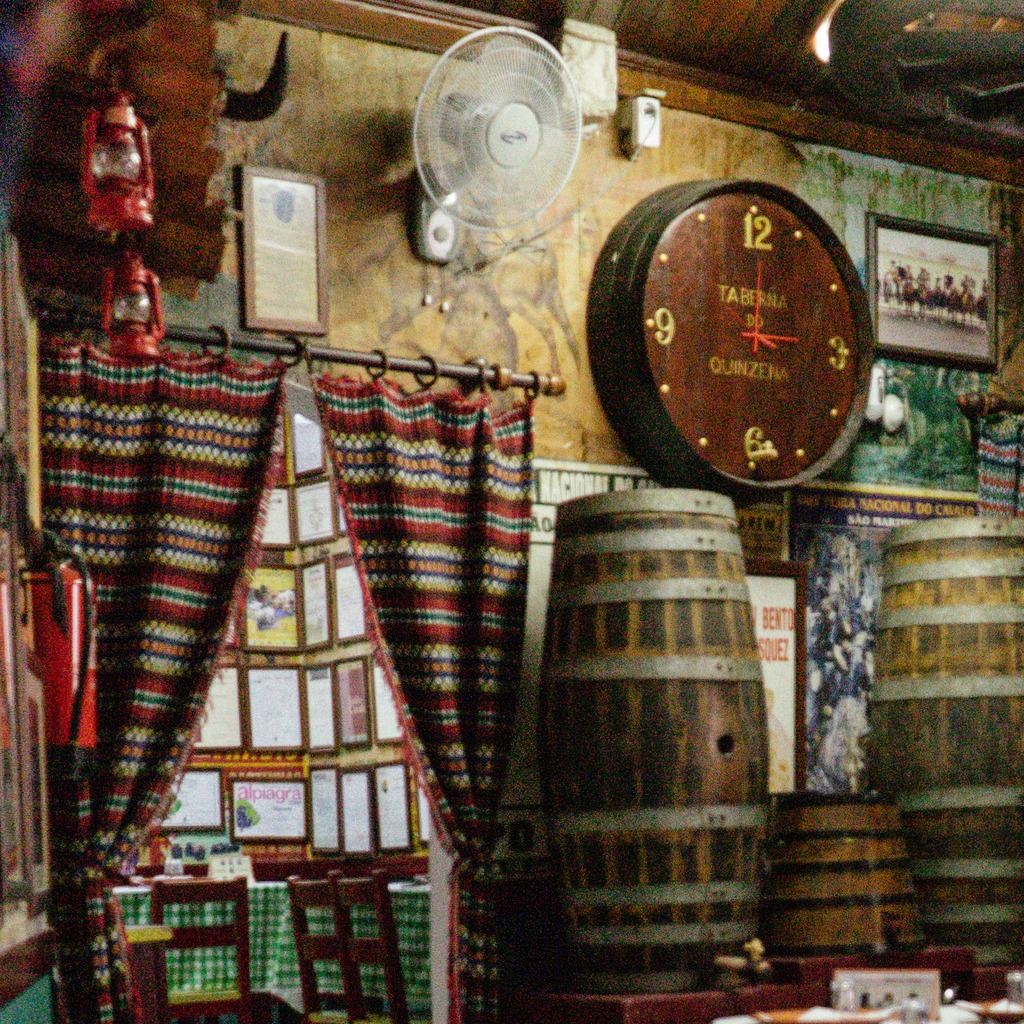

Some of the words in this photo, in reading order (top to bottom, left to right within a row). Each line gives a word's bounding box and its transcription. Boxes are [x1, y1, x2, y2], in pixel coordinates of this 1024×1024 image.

[744, 211, 773, 251] 12
[654, 307, 675, 346] 9
[828, 335, 850, 371] 3
[237, 785, 301, 806] alpiagra
